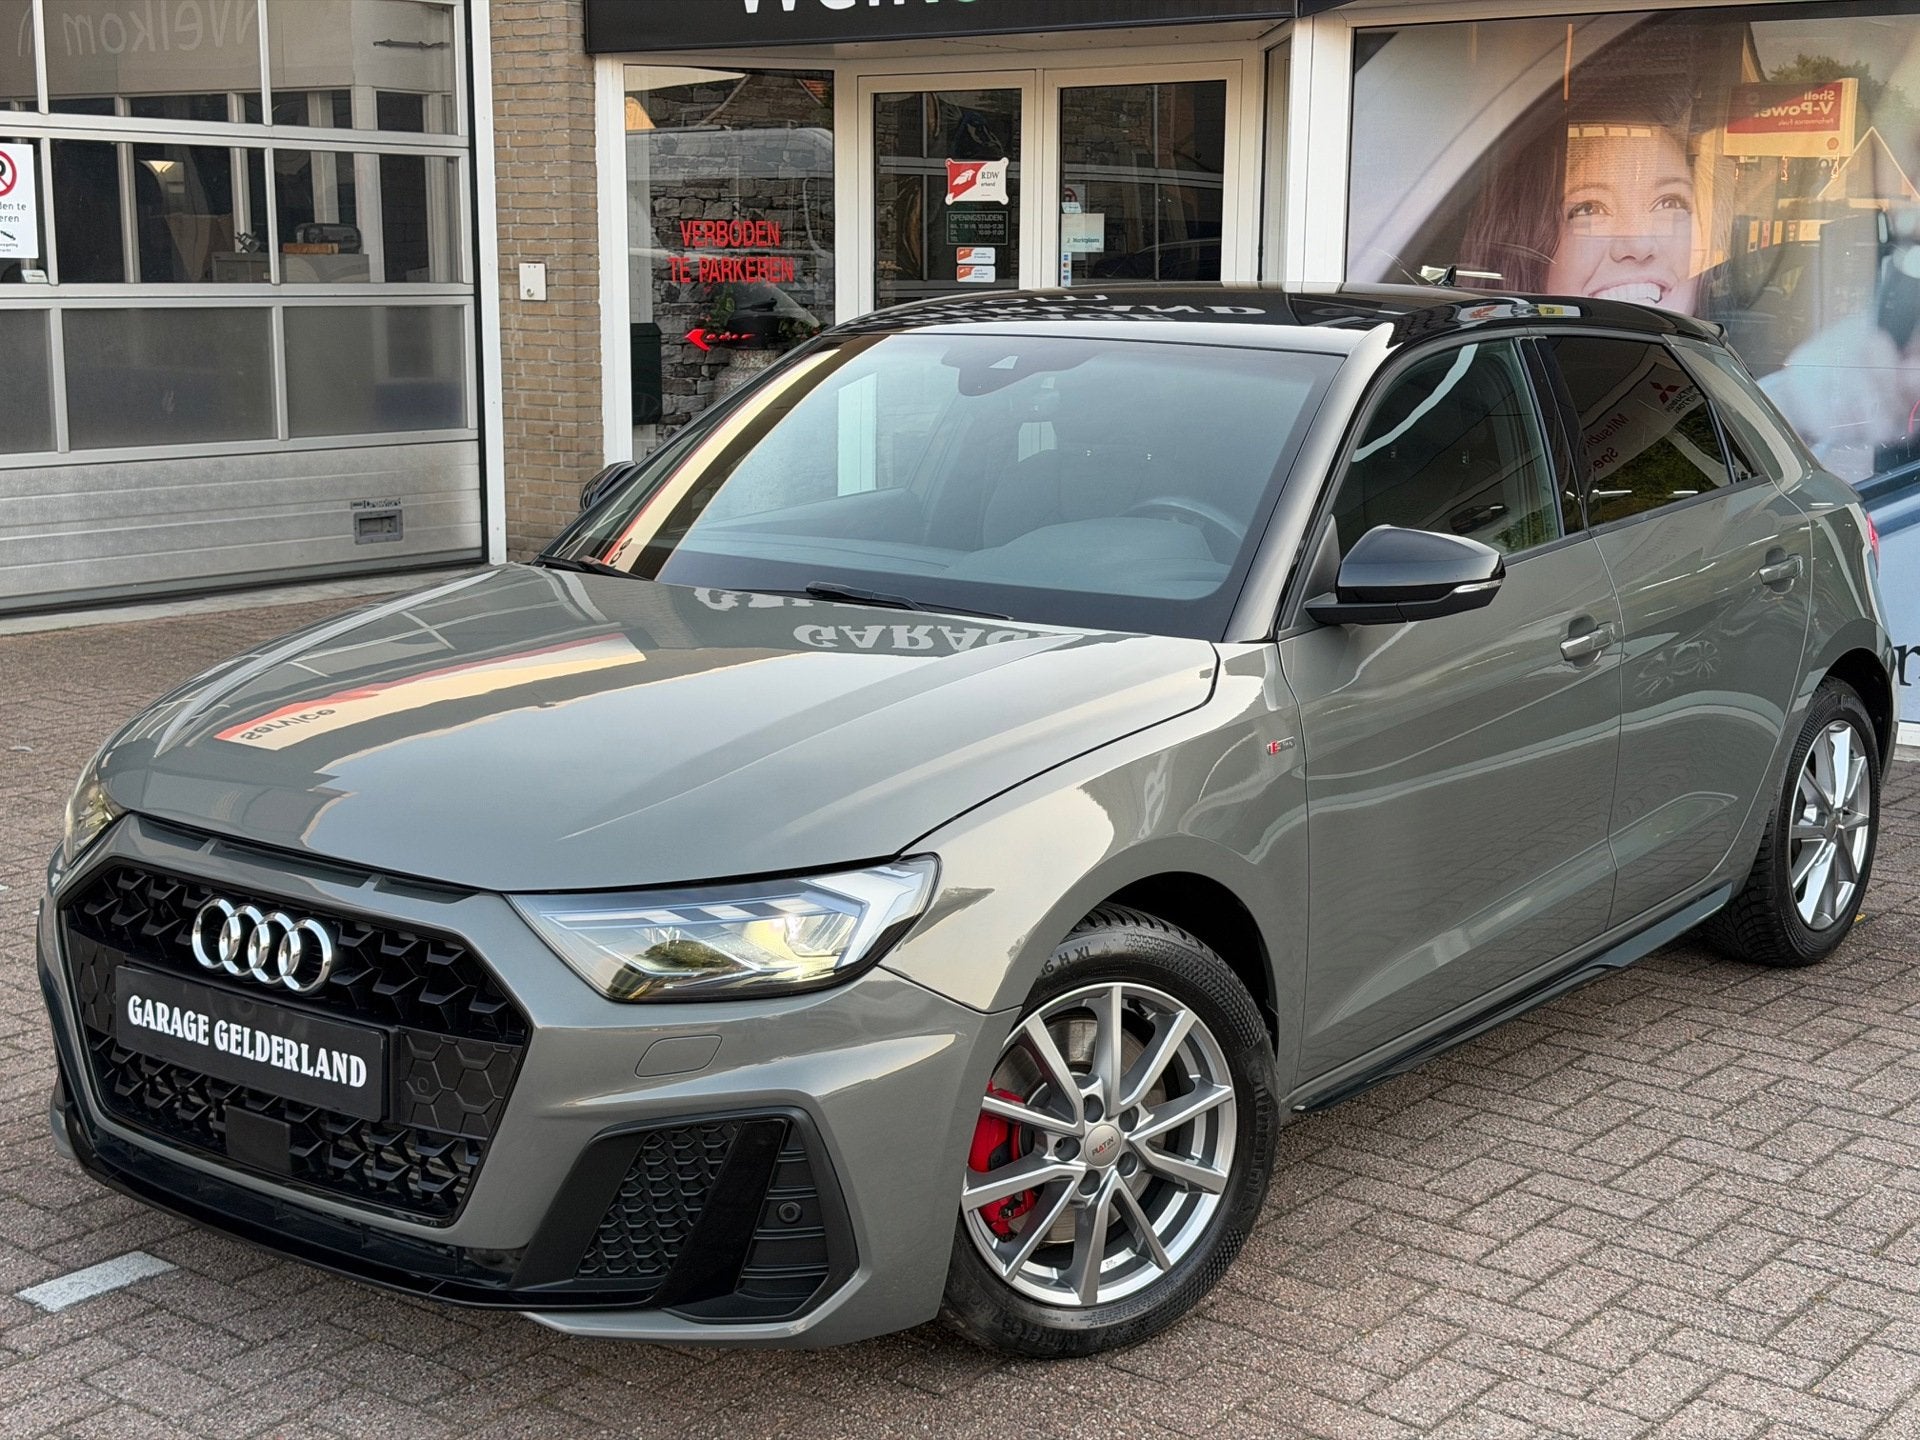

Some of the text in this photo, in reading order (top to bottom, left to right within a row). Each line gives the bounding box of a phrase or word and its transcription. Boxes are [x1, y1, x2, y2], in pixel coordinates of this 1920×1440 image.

[981, 171, 1000, 180] RDW
[679, 220, 781, 247] VERBODEN
[667, 256, 794, 284] TE PARKEREN
[1073, 945, 1096, 961] XL
[127, 994, 368, 1089] GARAGE GELDERLAND
